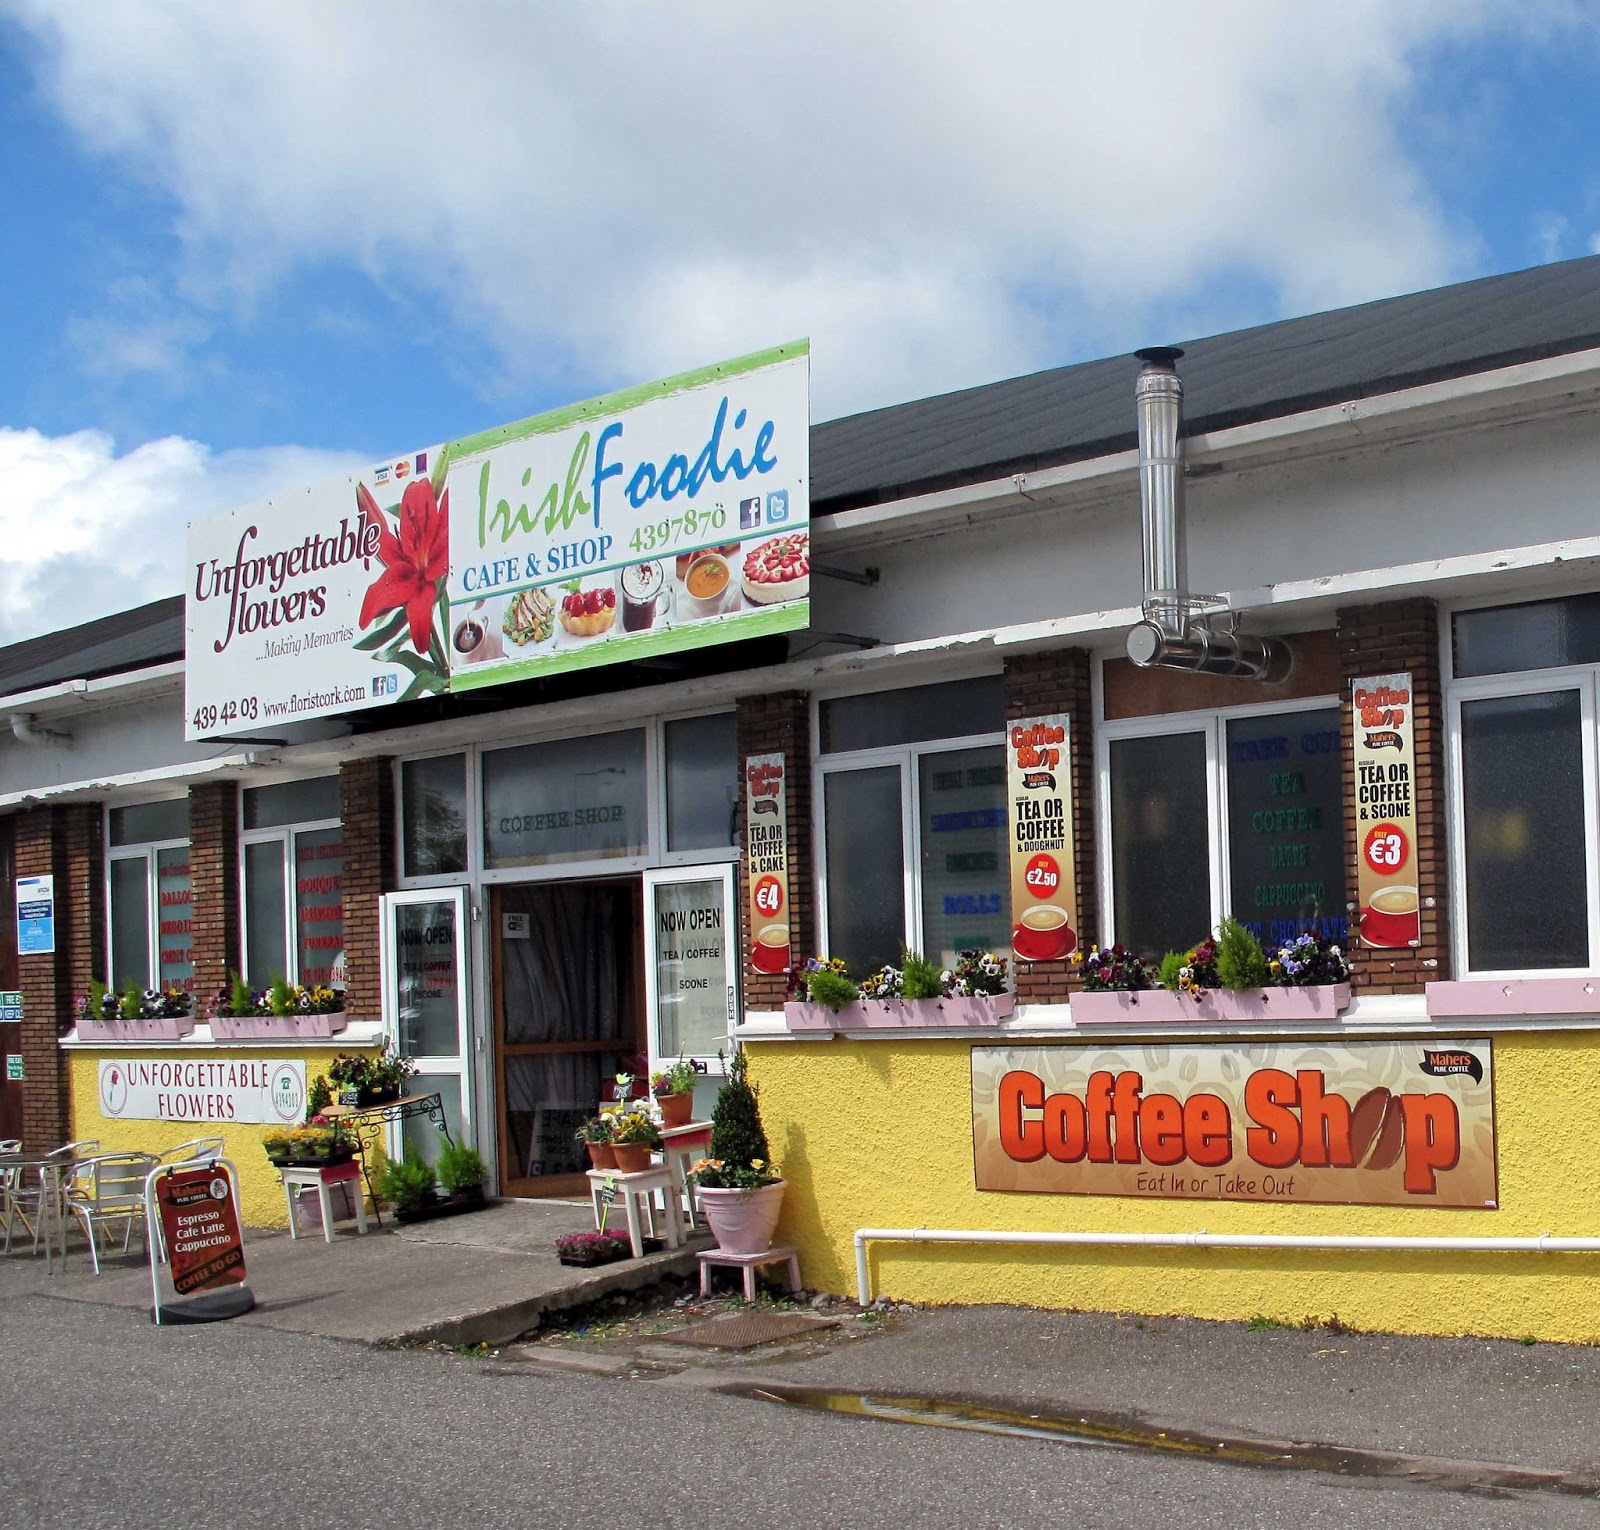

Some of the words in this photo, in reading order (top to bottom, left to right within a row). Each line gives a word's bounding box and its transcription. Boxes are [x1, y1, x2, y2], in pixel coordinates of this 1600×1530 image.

[478, 431, 592, 548] Irish
[591, 396, 778, 528] Foodie
[629, 508, 726, 553] 4397870
[195, 511, 381, 608] Unforgettable
[463, 558, 520, 592] CAFE
[525, 552, 542, 578] &
[547, 535, 613, 572] SHOP
[303, 627, 354, 648] Memories
[193, 705, 217, 730] 439
[220, 701, 237, 725] 42
[241, 697, 258, 719] 03
[263, 685, 365, 717] www.floristcork.com
[1354, 686, 1410, 709] Coffee
[1361, 706, 1405, 729] Shop
[1011, 723, 1065, 748] Coffee
[1017, 746, 1060, 770] Shop
[1268, 772, 1304, 795] TEA
[1359, 765, 1385, 784] TEA
[1388, 763, 1409, 782] OR
[1359, 783, 1410, 804] COFFEE
[1016, 800, 1041, 820] TEA
[1044, 798, 1063, 818] OR
[1360, 808, 1368, 820] &
[1371, 802, 1410, 819] SCONE
[750, 826, 767, 841] TEA
[769, 825, 782, 840] OR
[1016, 819, 1065, 841] COFFEE
[750, 840, 783, 858] COFFEE
[1017, 843, 1023, 852] &
[1024, 839, 1065, 852] DOUGHNUT
[1369, 835, 1401, 865] €3
[751, 861, 758, 873] &
[760, 856, 784, 873] CAKE
[1027, 868, 1057, 886] €2.50
[757, 884, 778, 910] €4
[1255, 882, 1326, 907] CAPPUCCINO
[661, 911, 687, 933] NOW
[690, 908, 720, 930] OPEN
[400, 927, 423, 946] NOW
[425, 926, 452, 945] OPEN
[663, 950, 679, 960] TEA
[687, 947, 720, 959] COFFEE
[418, 990, 442, 999] SCONE
[679, 978, 708, 990] SCONE
[1430, 1053, 1472, 1066] Mahers
[127, 1063, 269, 1088] UNFORGETTABLE
[159, 1093, 235, 1119] FLOWERS
[998, 1070, 1234, 1166] Coffee
[1244, 1068, 1461, 1195] Shop
[1137, 1172, 1168, 1193] Eat
[1170, 1173, 1186, 1193] In
[1187, 1178, 1210, 1193] or
[1215, 1174, 1257, 1196] Take
[1262, 1175, 1295, 1197] Out
[177, 1211, 219, 1227] Espresso
[176, 1226, 199, 1239] Cafe
[201, 1222, 225, 1236] Latte
[175, 1234, 231, 1253] Cappuccino
[176, 1268, 211, 1292] COFFEE
[211, 1260, 225, 1273] TO
[226, 1250, 241, 1265] GO
